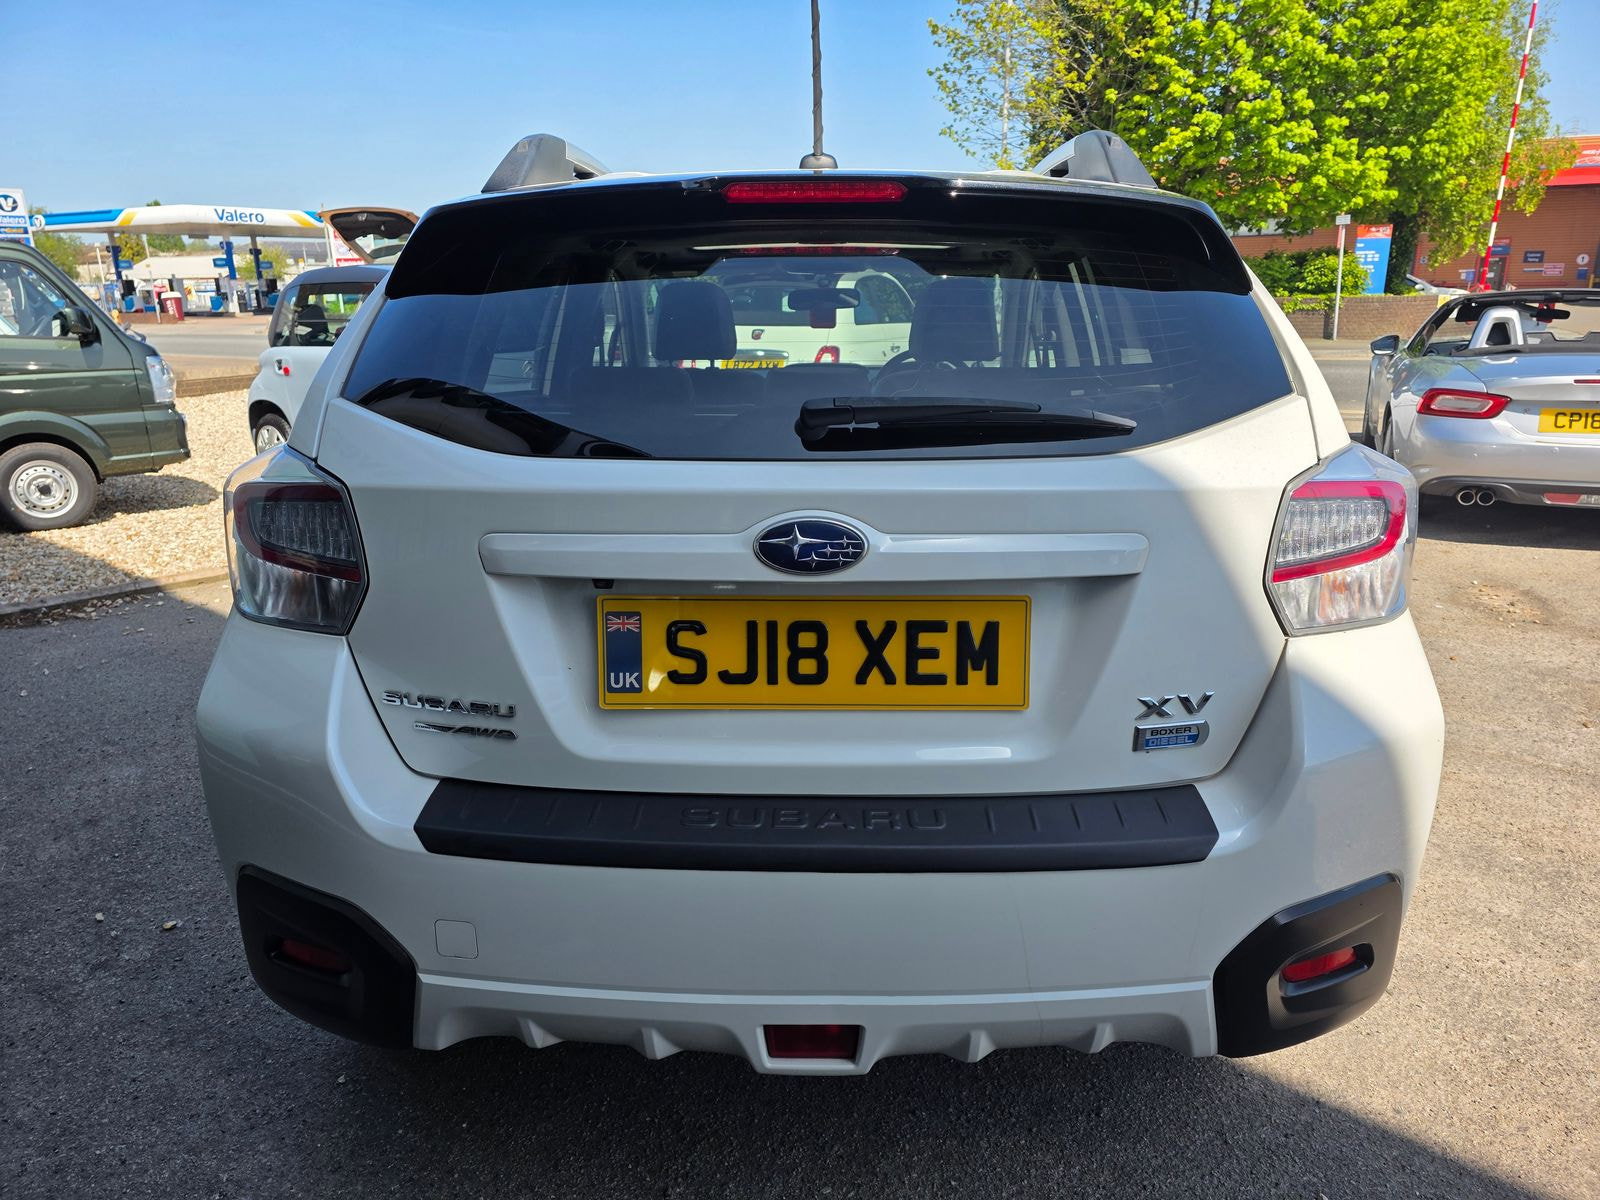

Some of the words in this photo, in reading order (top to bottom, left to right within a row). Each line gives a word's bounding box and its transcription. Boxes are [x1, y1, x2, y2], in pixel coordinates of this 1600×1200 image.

[214, 208, 264, 223] Valero
[1554, 411, 1600, 429] CP18
[665, 619, 829, 685] SJ18
[855, 619, 1000, 686] XEM
[610, 672, 640, 688] UK
[382, 690, 516, 718] SUBARU
[1134, 690, 1215, 719] XV
[453, 725, 517, 740] AWD
[1150, 726, 1192, 736] BOXER
[1149, 736, 1193, 746] DIESEL
[679, 807, 947, 831] SUBARU
